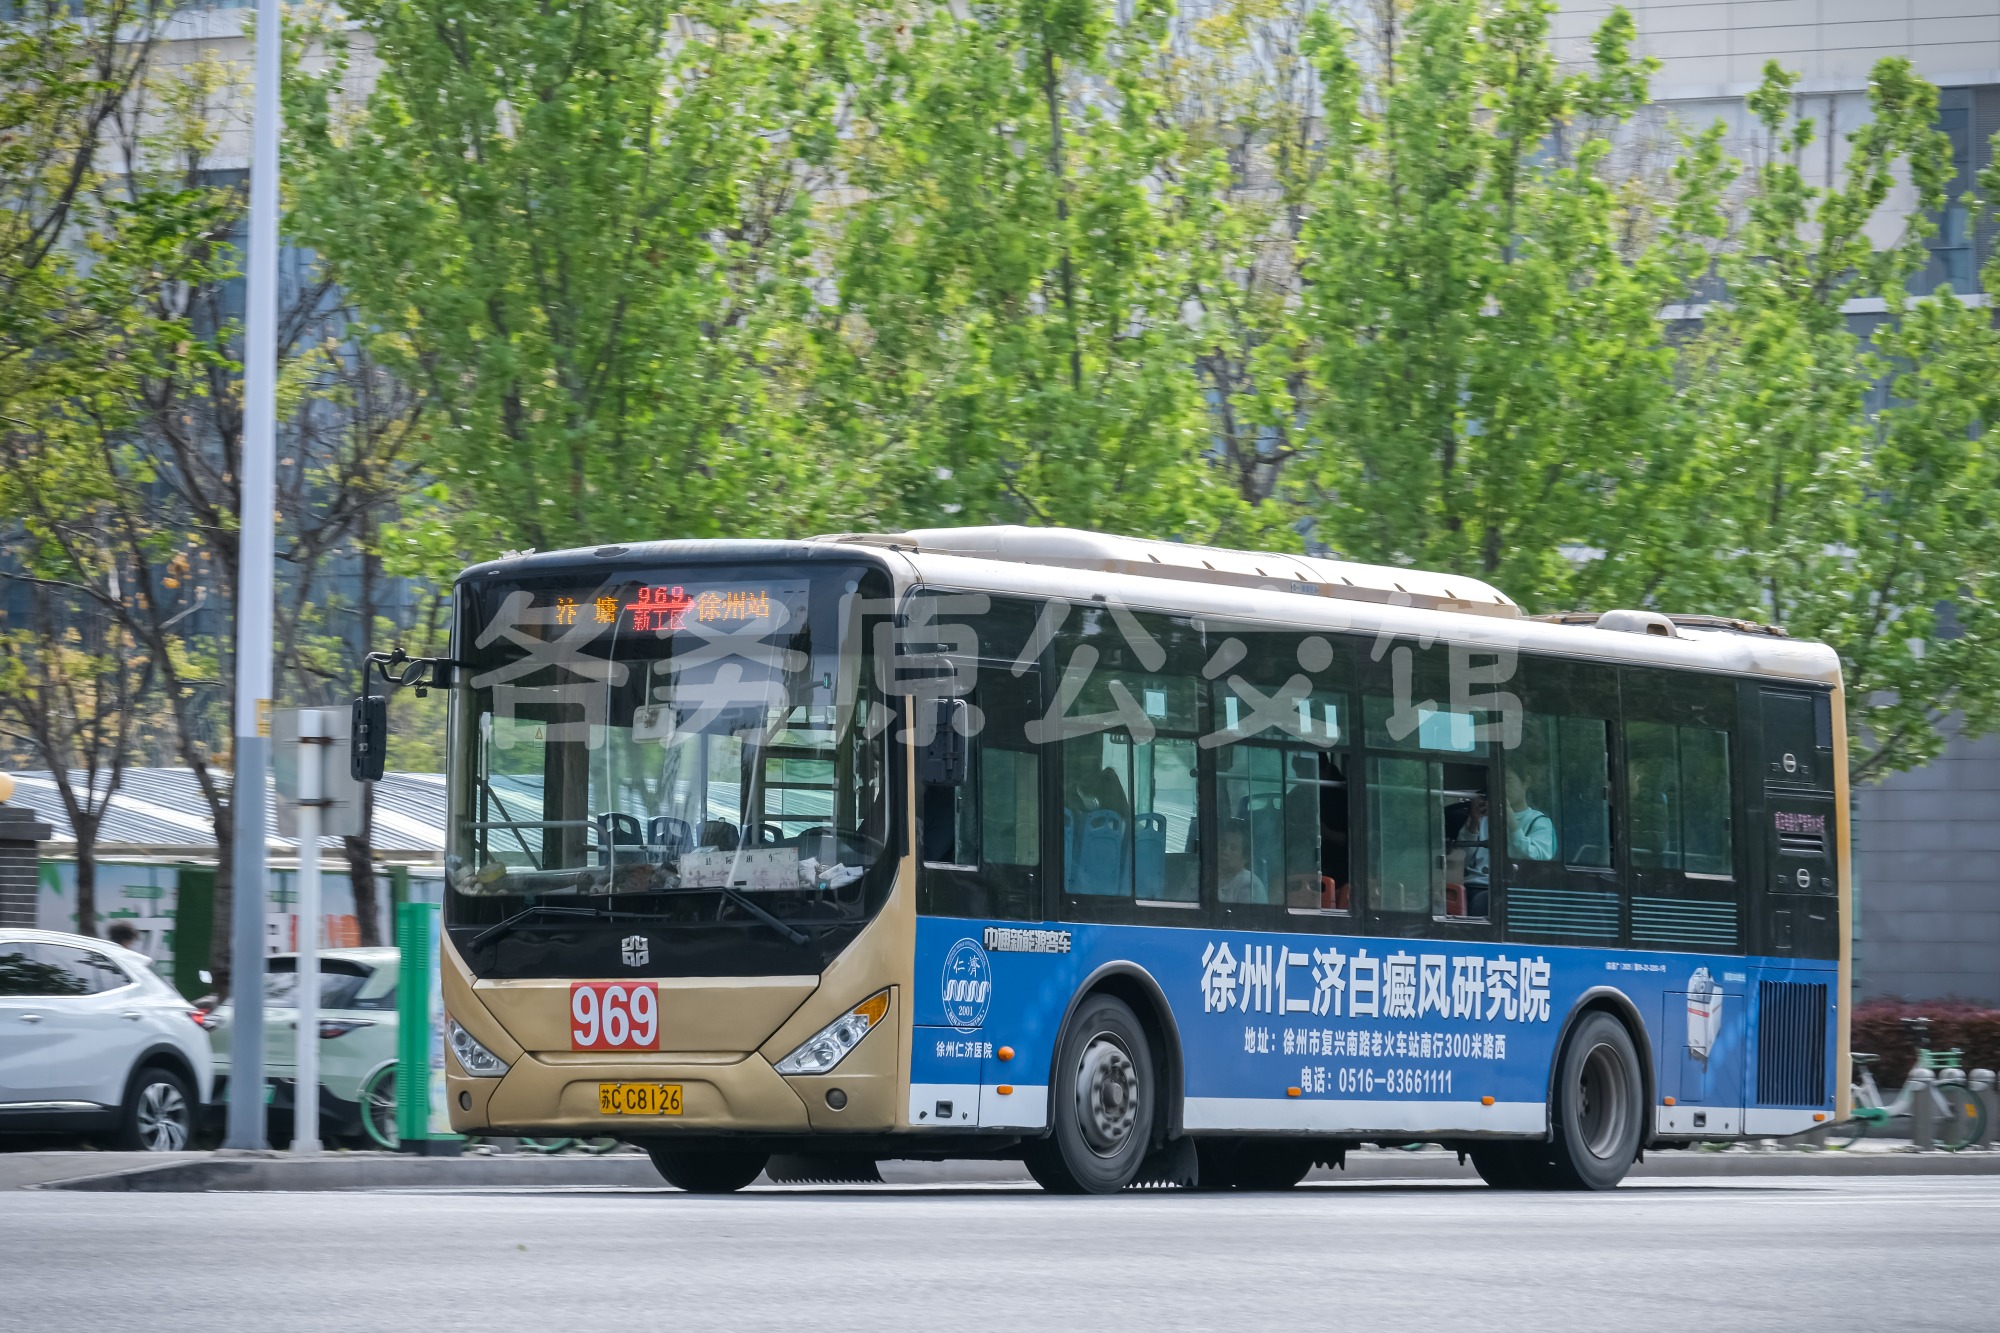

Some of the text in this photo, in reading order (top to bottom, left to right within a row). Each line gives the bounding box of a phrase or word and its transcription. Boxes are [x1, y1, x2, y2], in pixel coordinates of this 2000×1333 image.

[638, 586, 684, 604] 969
[698, 591, 770, 622] 徐州站
[633, 608, 686, 630] 新工区
[984, 927, 1072, 953] 中通新能源客车
[1201, 941, 1551, 1023] 徐州仁济白癜风研究院
[572, 985, 658, 1047] 969
[958, 1005, 973, 1017] 2001
[936, 1041, 993, 1059] 徐州仁济医院
